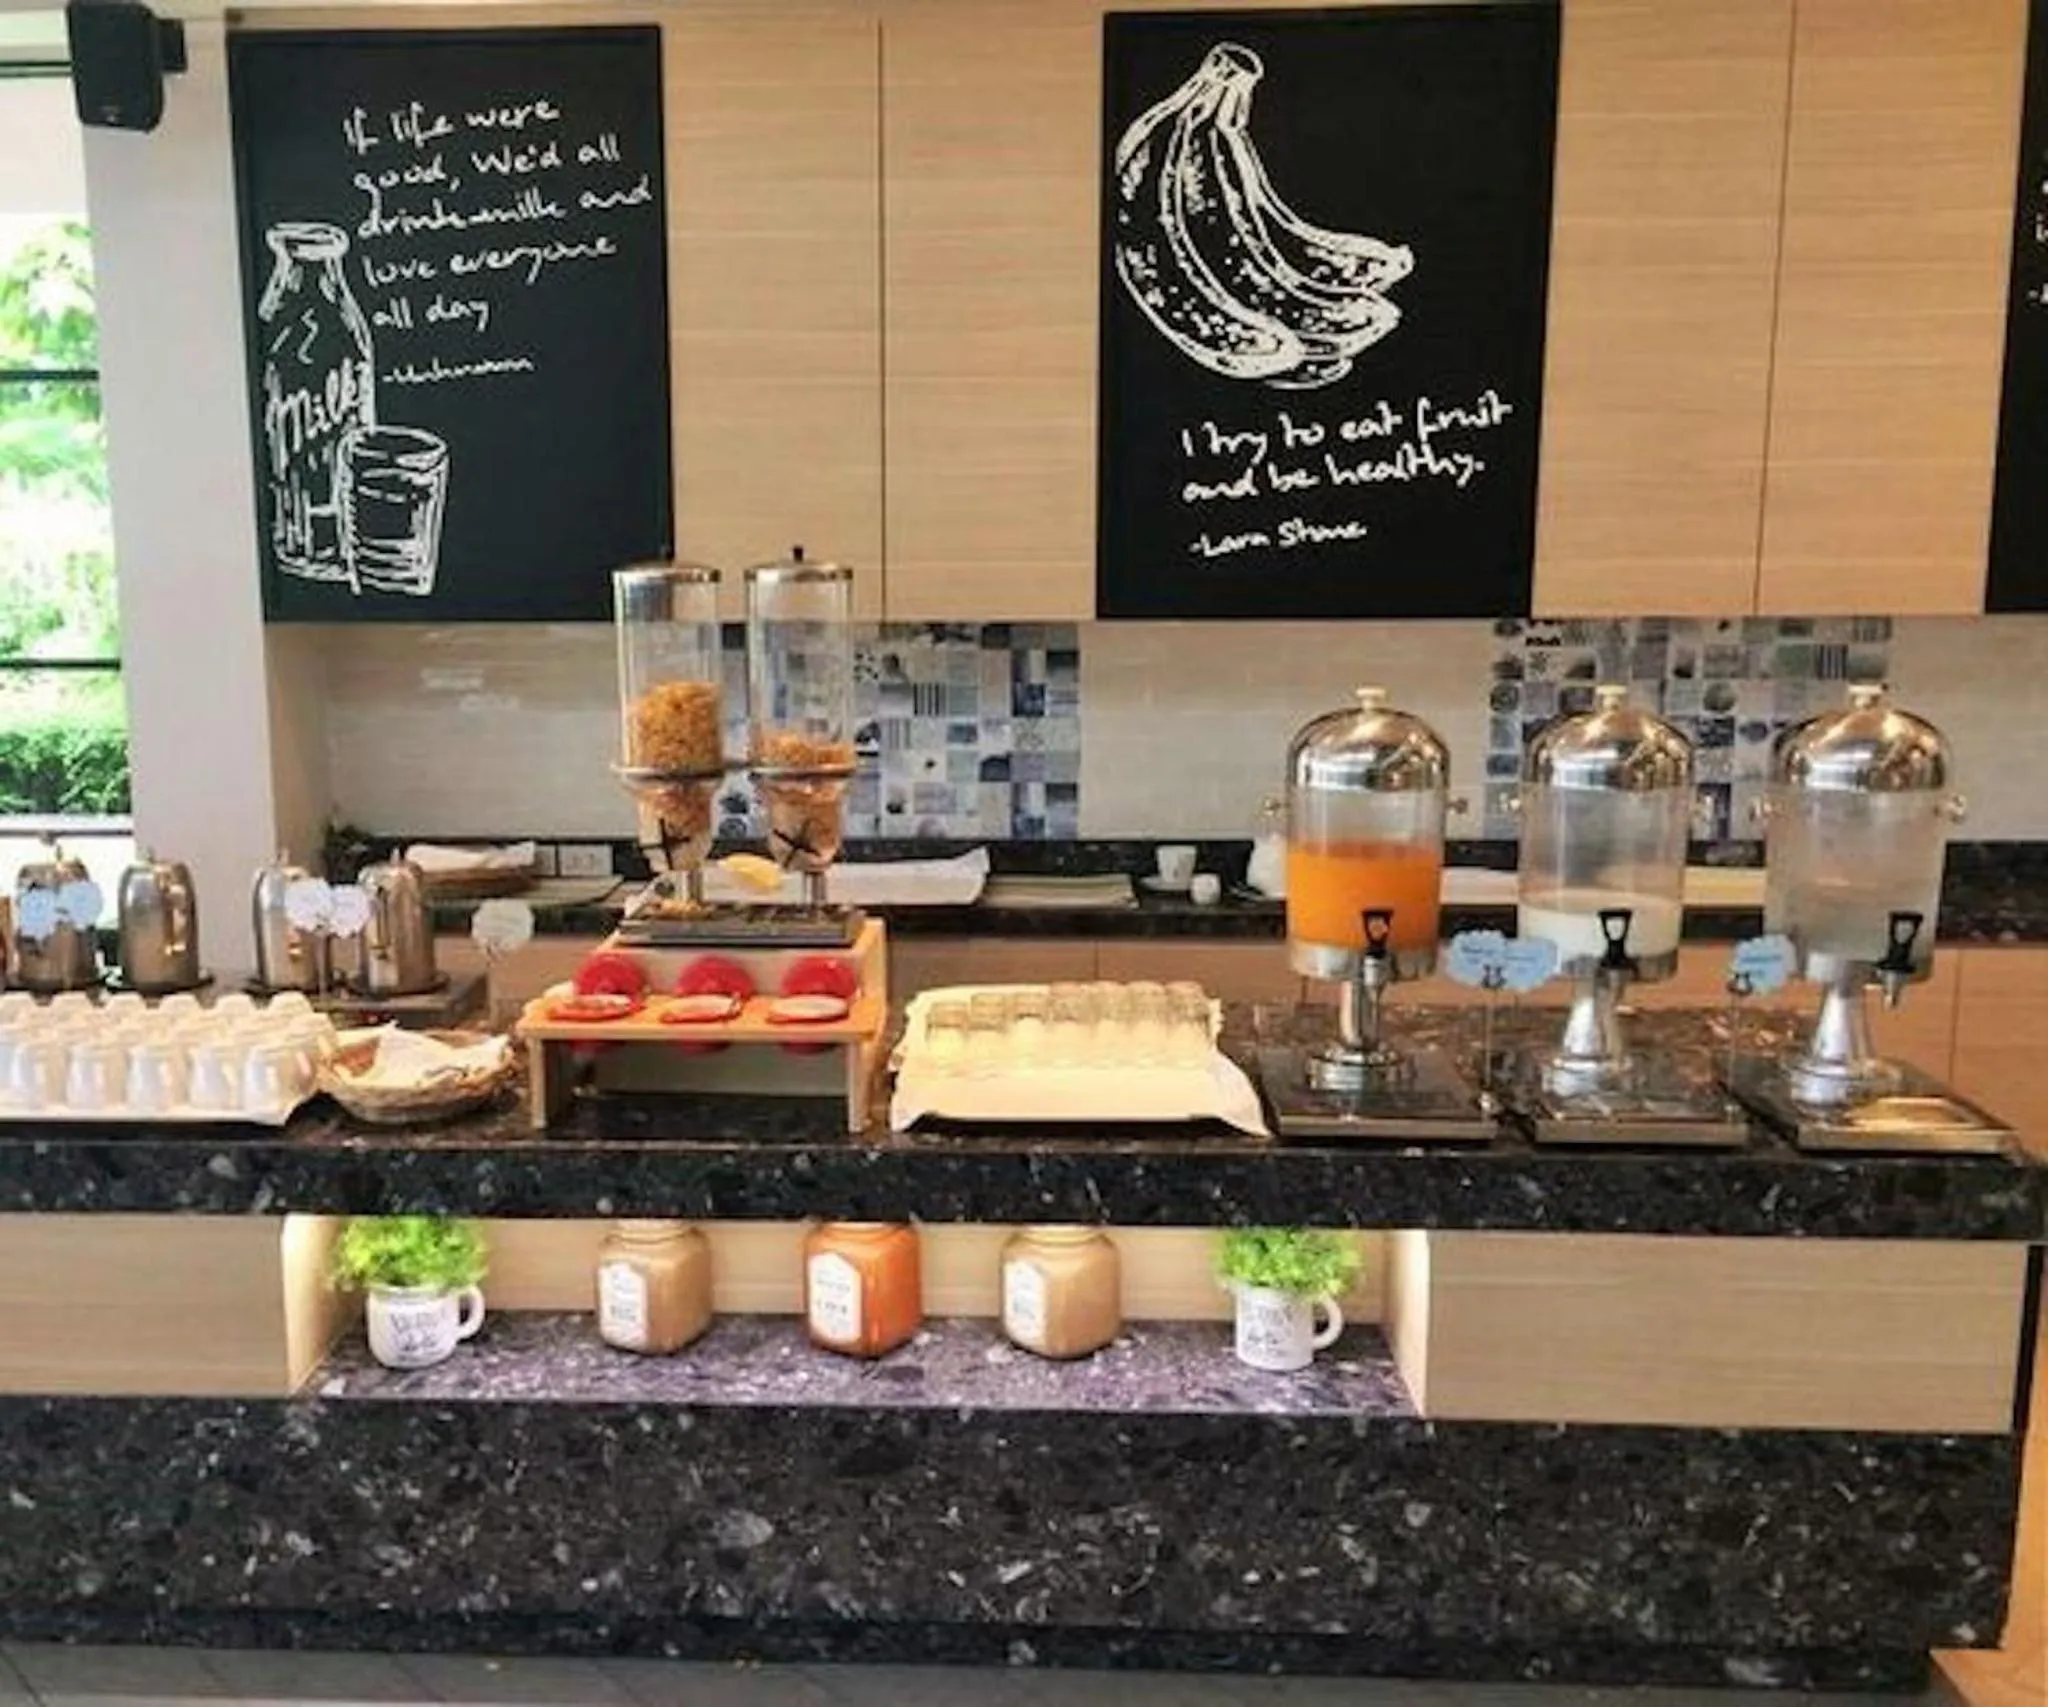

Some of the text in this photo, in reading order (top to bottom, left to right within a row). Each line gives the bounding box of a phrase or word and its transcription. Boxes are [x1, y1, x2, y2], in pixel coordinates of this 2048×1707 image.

[344, 100, 559, 154] If life were
[354, 134, 620, 200] good, We'd all
[358, 192, 467, 238] drink
[579, 175, 652, 208] and
[363, 236, 616, 287] love everyone
[373, 295, 488, 331] all day
[265, 357, 360, 474] Milk
[1182, 390, 1513, 464] I try to eat fruit
[1182, 443, 1485, 503] and be healthy.
